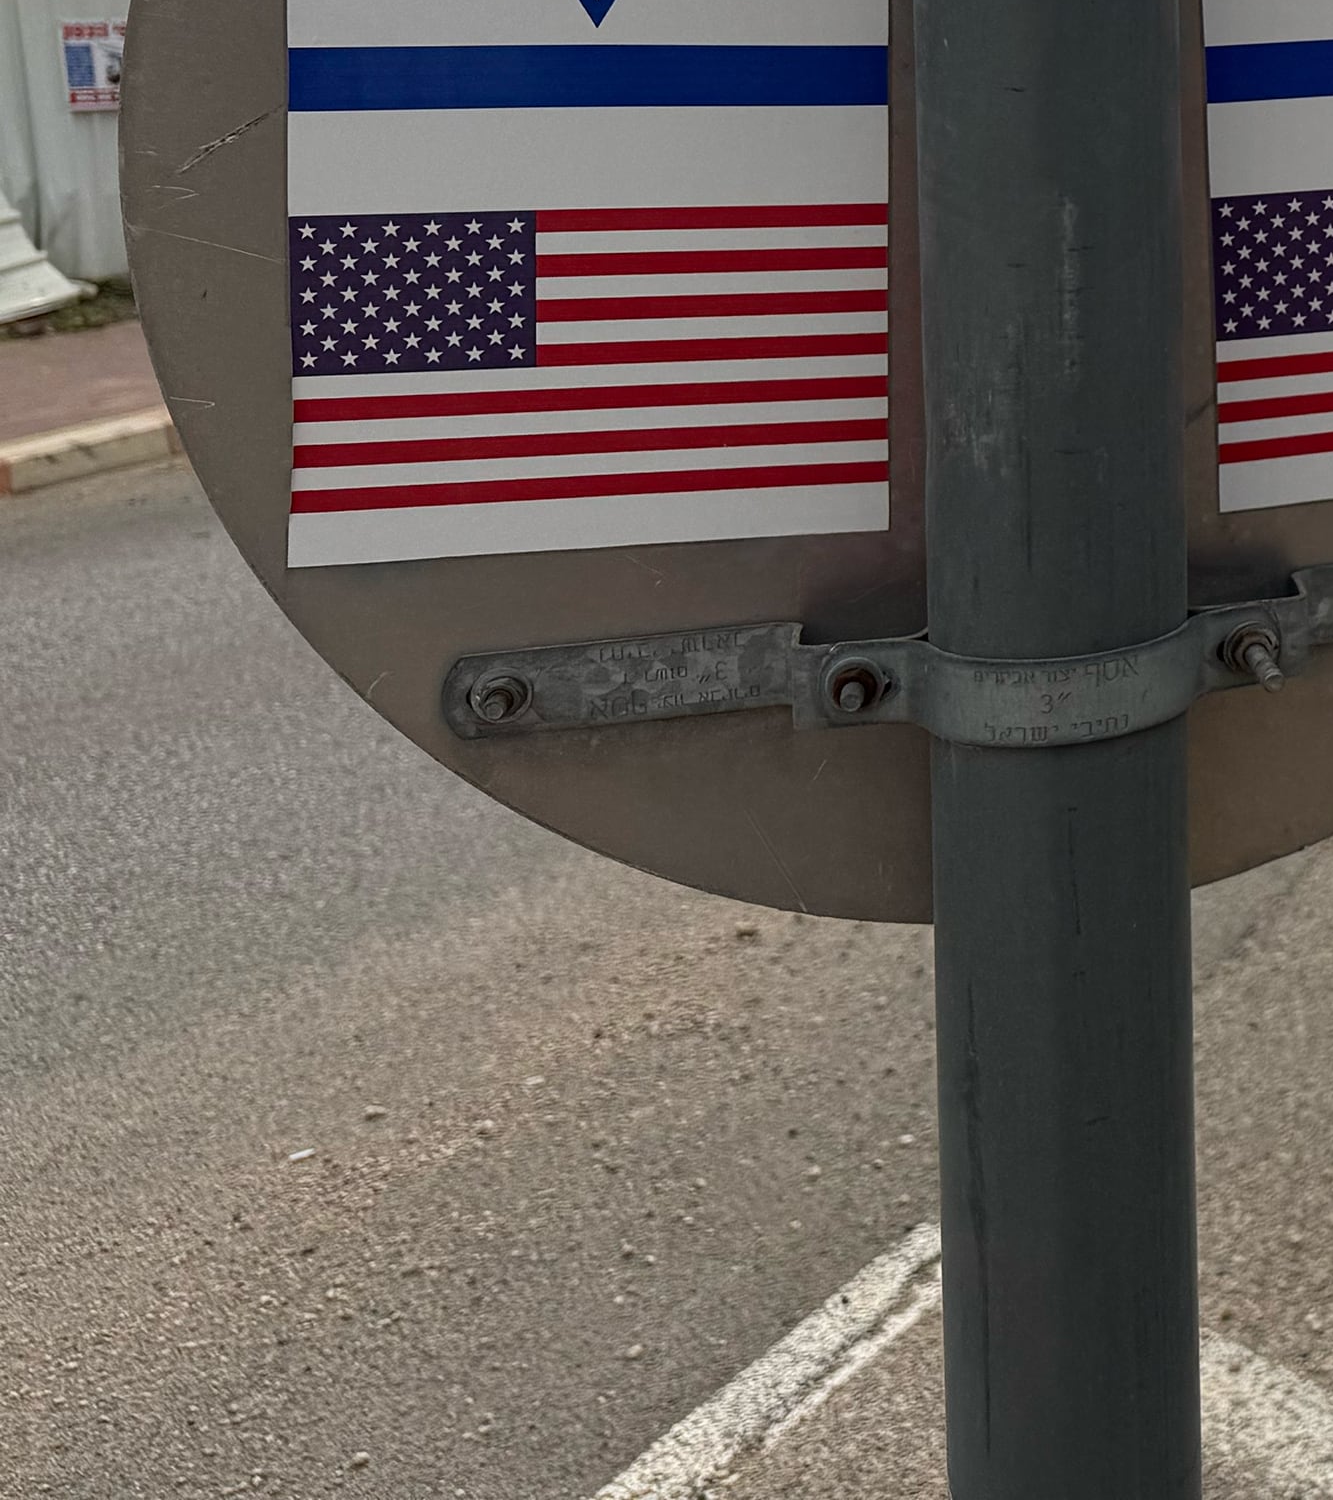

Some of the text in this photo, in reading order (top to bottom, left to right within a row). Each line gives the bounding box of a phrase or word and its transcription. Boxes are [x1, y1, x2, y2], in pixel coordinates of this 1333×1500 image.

[1039, 667, 1078, 684] יצור
[1085, 654, 1140, 688] אסף
[982, 713, 1130, 743] נתיבי ישראל
